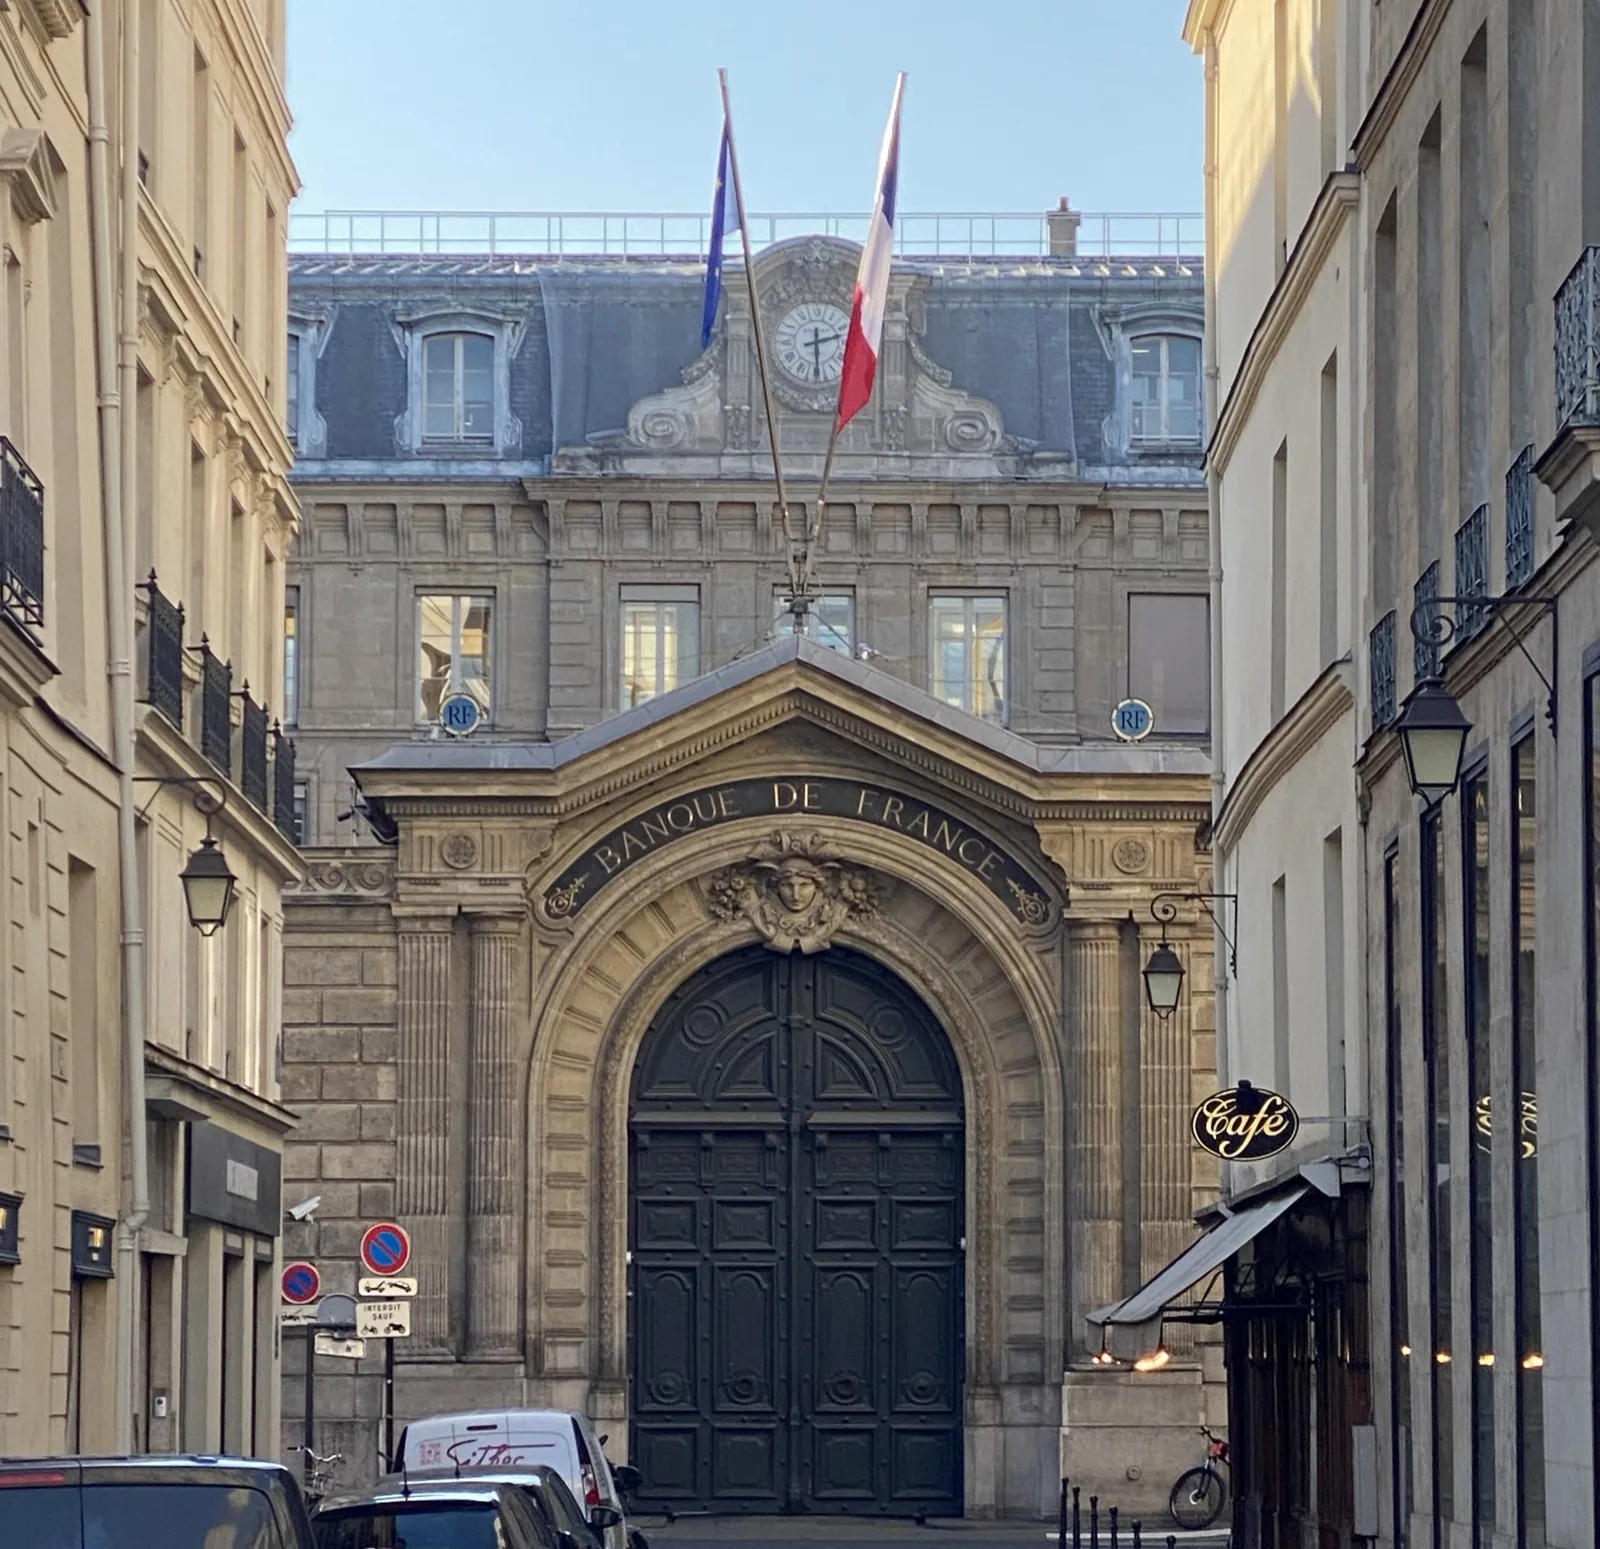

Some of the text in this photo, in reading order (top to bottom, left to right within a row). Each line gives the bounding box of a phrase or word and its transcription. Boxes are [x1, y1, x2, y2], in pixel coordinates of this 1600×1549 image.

[448, 704, 473, 725] RF
[1121, 710, 1145, 729] RF
[594, 783, 1005, 881] BANQUE DE FRANCE
[1203, 1096, 1289, 1157] Café
[363, 1303, 401, 1312] INTERDIT
[372, 1313, 393, 1321] SAUF
